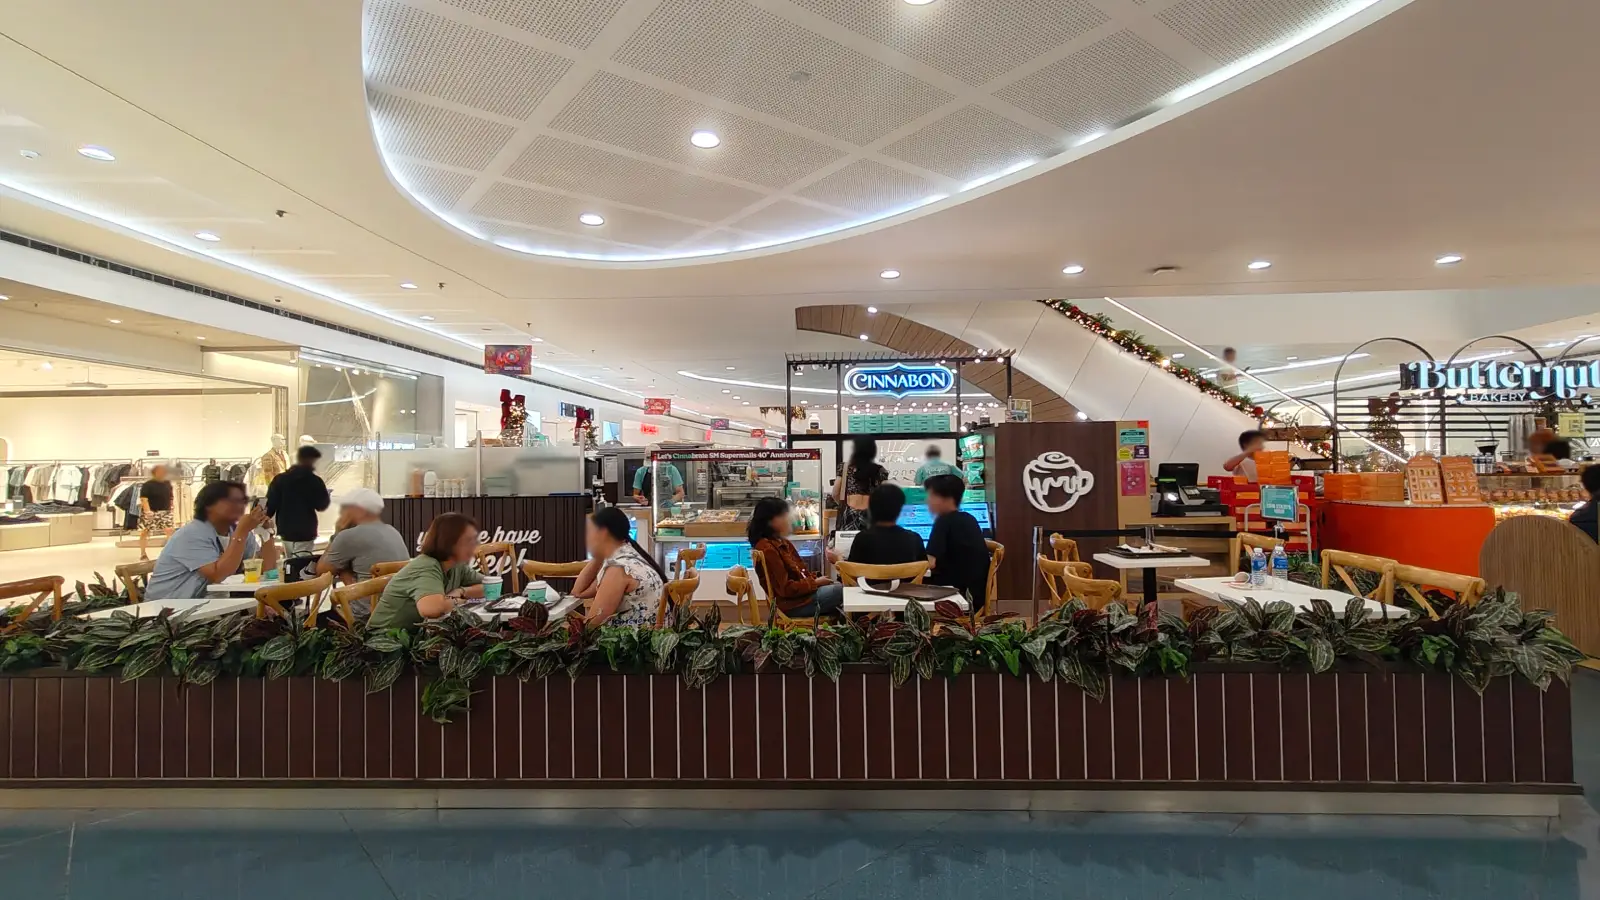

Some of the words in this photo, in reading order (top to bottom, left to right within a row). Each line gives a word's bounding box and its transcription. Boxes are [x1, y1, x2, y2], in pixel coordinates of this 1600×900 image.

[1470, 392, 1527, 402] BAKERY
[709, 452, 719, 460] SM
[720, 452, 758, 461] Supermalls
[770, 451, 810, 460] Anniversary
[492, 526, 541, 544] have
